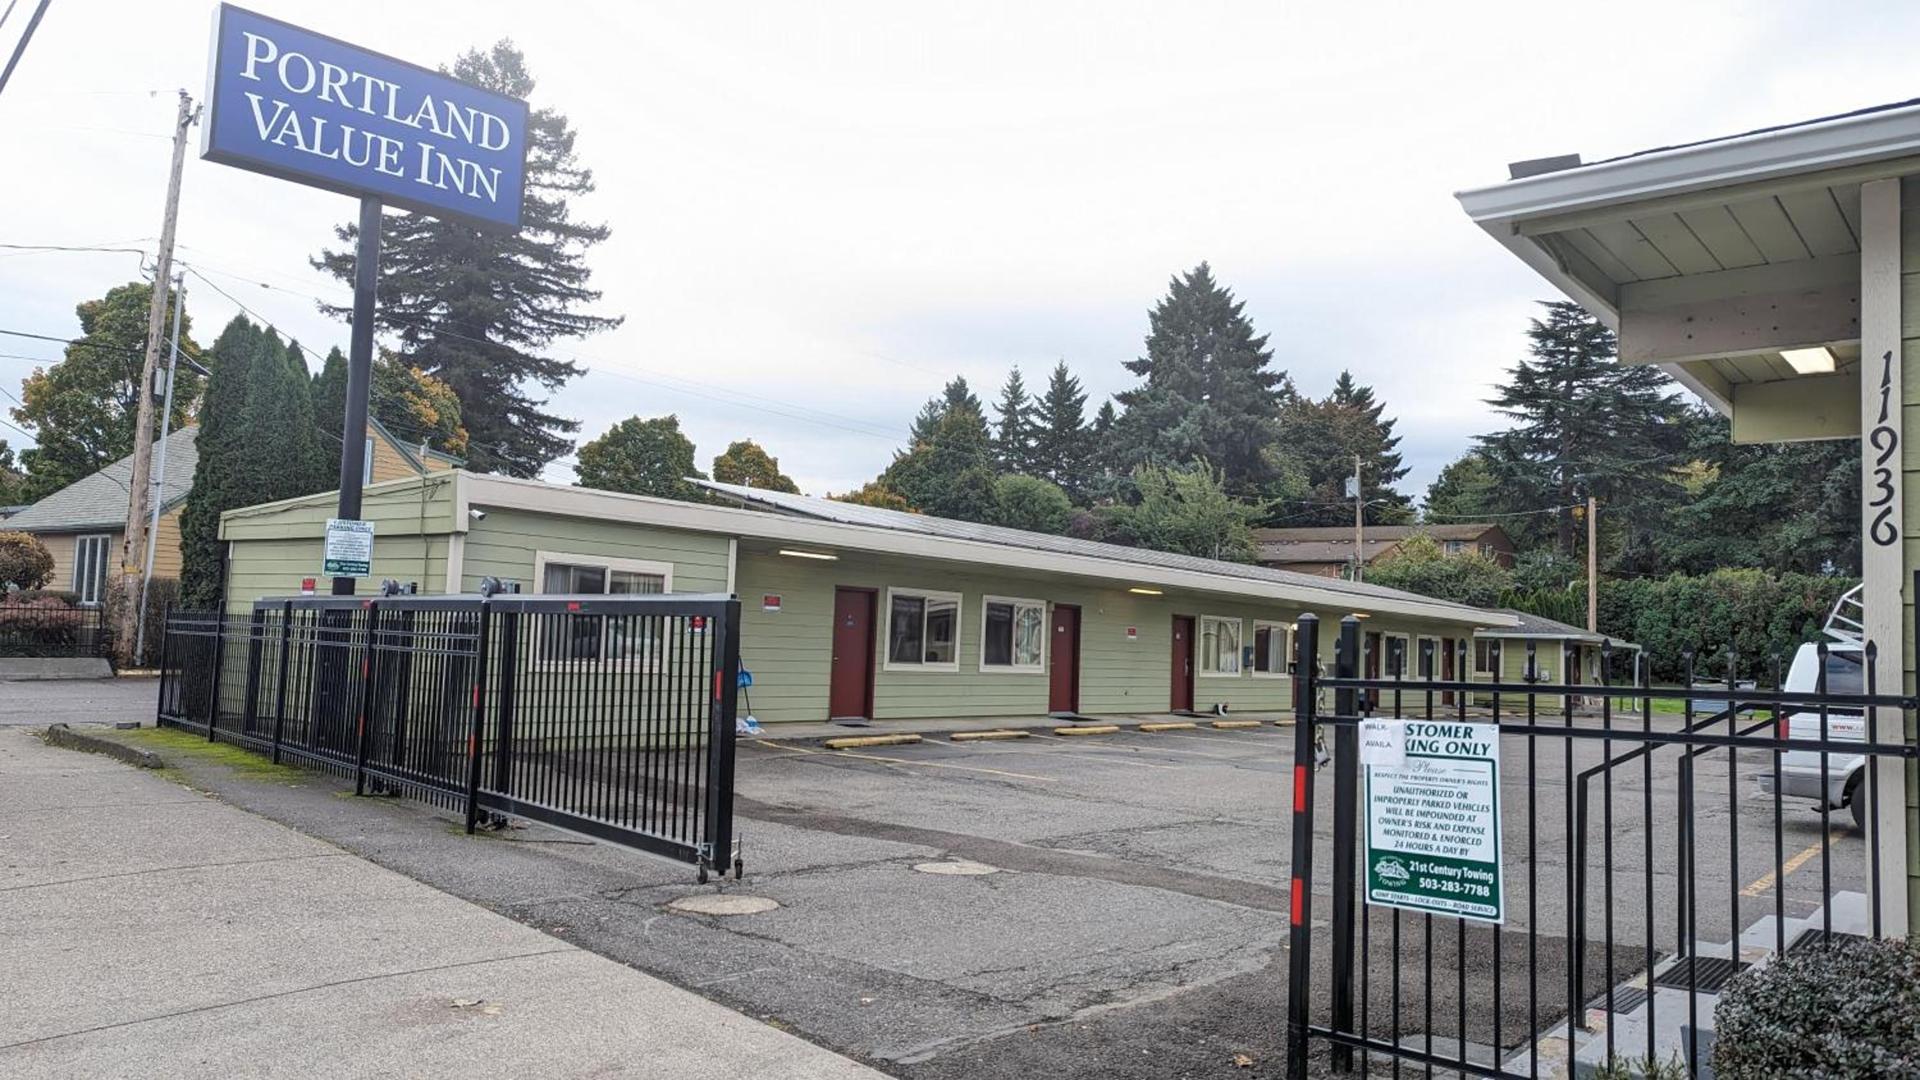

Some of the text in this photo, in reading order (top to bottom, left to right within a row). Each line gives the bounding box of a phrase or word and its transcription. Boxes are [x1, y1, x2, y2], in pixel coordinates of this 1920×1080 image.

[239, 31, 511, 152] PORTLAND
[243, 91, 503, 204] VALUE INN
[1869, 350, 1898, 547] 11936
[1404, 723, 1473, 739] STOMER
[1404, 739, 1491, 756] KING ONLY
[1412, 760, 1447, 774] Please
[1410, 774, 1439, 782] PROPERTY
[1393, 786, 1469, 800] UNAUTHORIZED OR
[1374, 795, 1491, 813] IMPROPERLY PARKED VEHICLES
[1385, 807, 1477, 823] WILL BE IMPOUNDED AT
[1378, 817, 1486, 835] OWNER'S RISK AND EXPENSE
[1383, 828, 1482, 846] MONITORED & ENFORCED
[1393, 840, 1470, 856] 24 HOURS A DAY BY
[1409, 860, 1494, 884] 21st Century Towing
[1418, 877, 1491, 897] 503-283-7788
